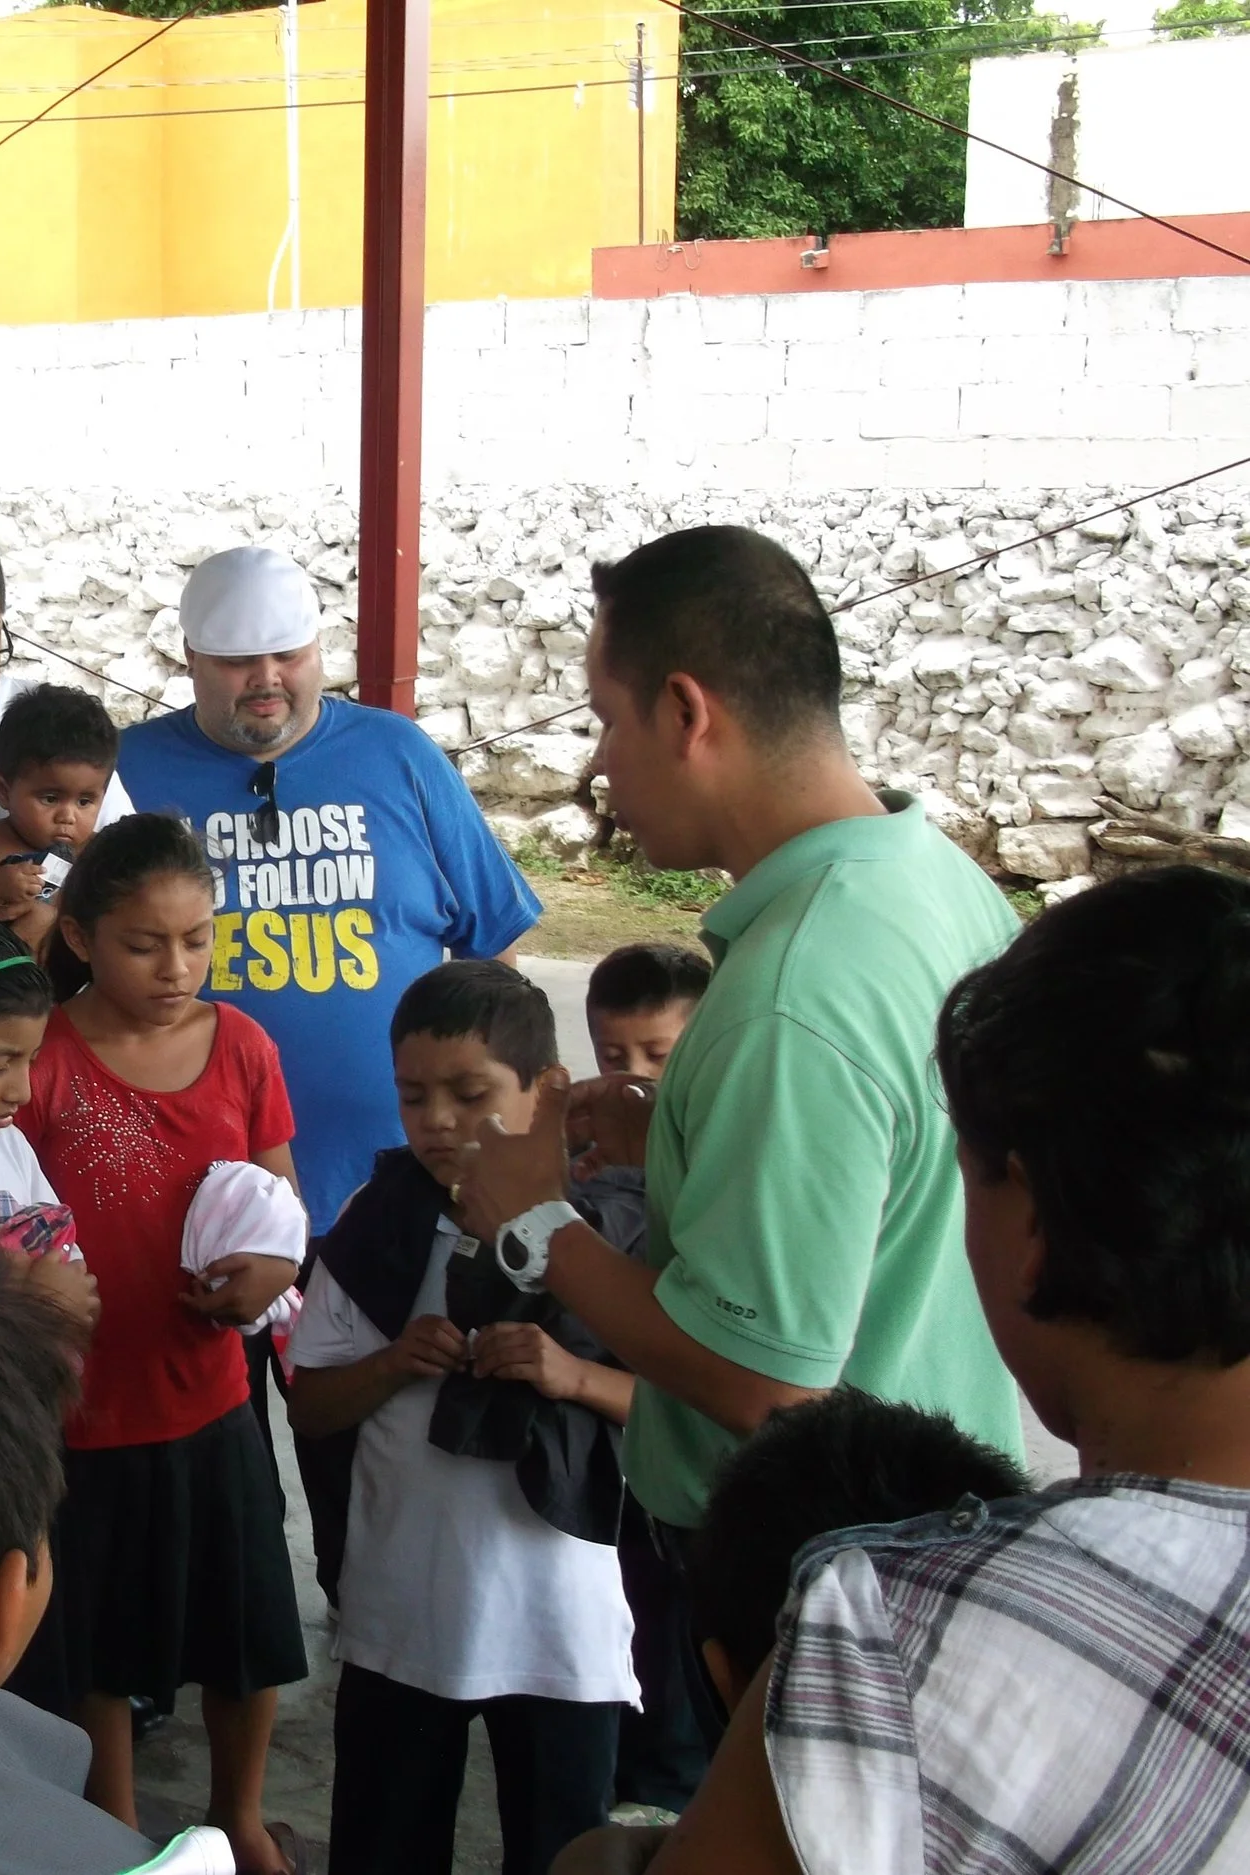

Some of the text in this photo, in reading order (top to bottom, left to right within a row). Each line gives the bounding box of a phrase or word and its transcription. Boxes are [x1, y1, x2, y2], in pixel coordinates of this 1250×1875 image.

[205, 804, 371, 860] CHOOSE
[237, 854, 374, 910] FOLLOW
[210, 908, 379, 993] ESUS
